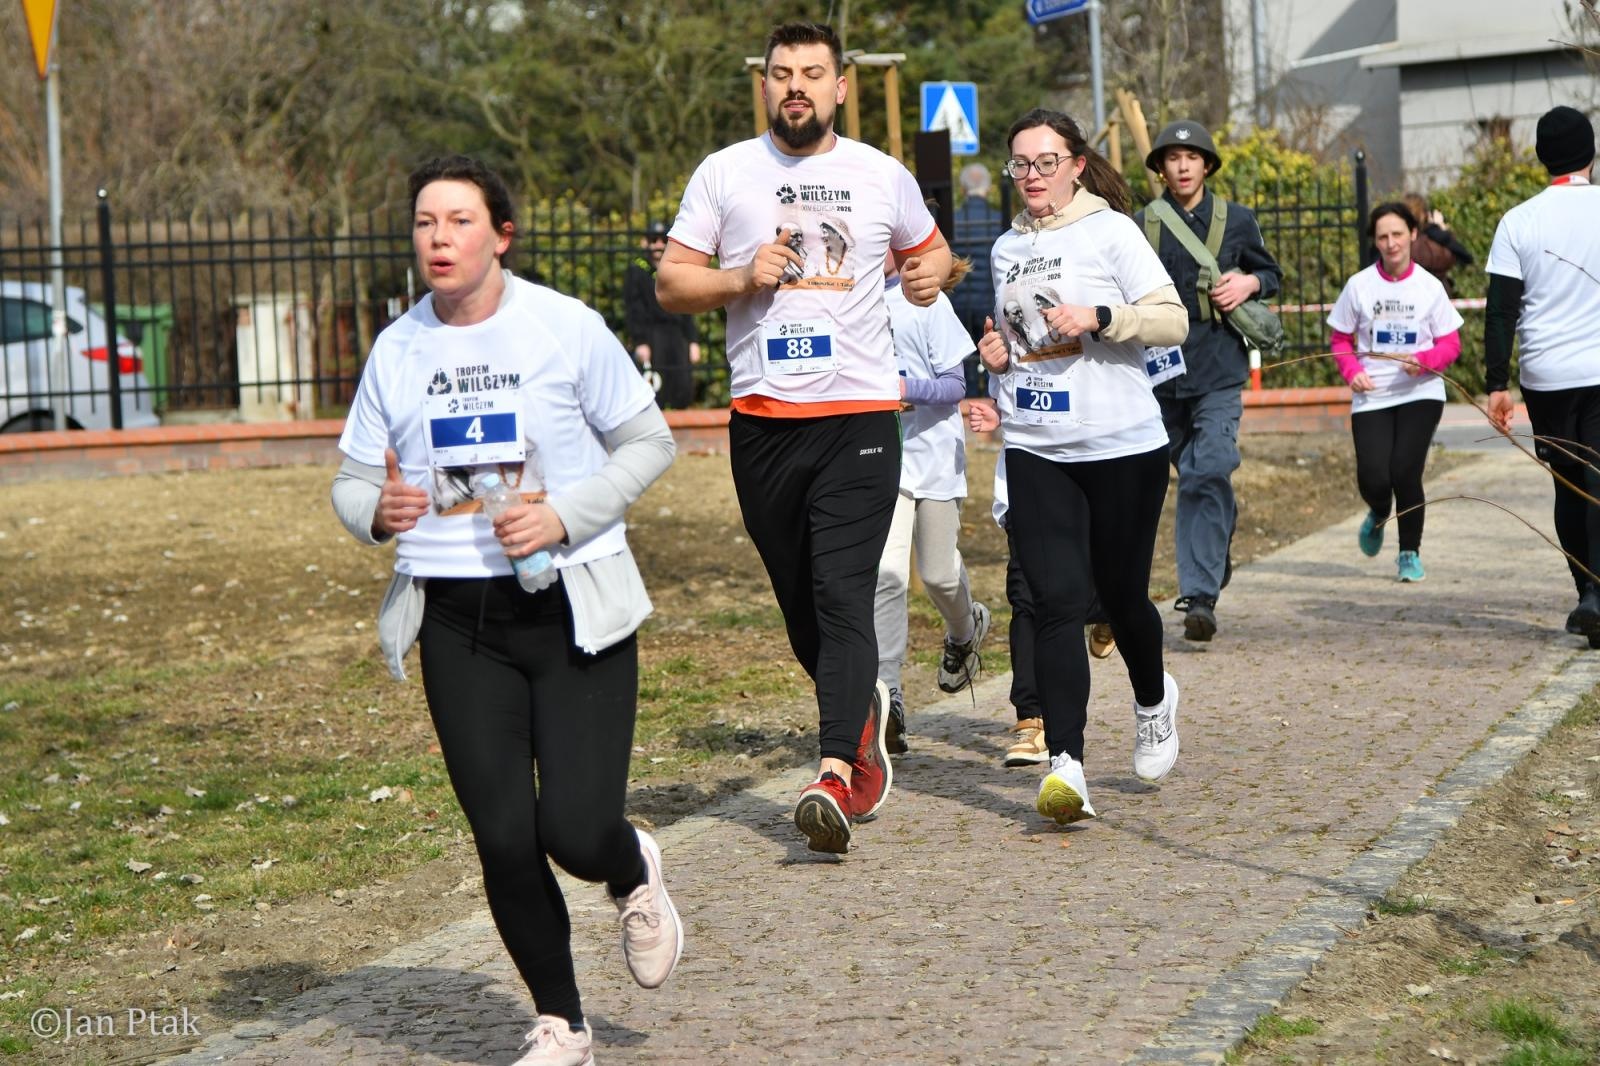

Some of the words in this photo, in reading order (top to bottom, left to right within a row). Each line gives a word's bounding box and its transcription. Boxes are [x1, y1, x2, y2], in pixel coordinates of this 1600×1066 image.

[800, 190, 851, 201] WILCZYM
[1022, 257, 1062, 275] WILCZYM
[790, 326, 815, 334] WILCZYM
[1389, 331, 1406, 344] 35
[786, 338, 813, 358] 88
[456, 364, 489, 377] TROPEM
[1156, 355, 1173, 371] 52
[457, 373, 520, 393] WILCZYM
[463, 400, 494, 411] WILCZYM
[1030, 391, 1052, 410] 20
[465, 416, 485, 443] 4
